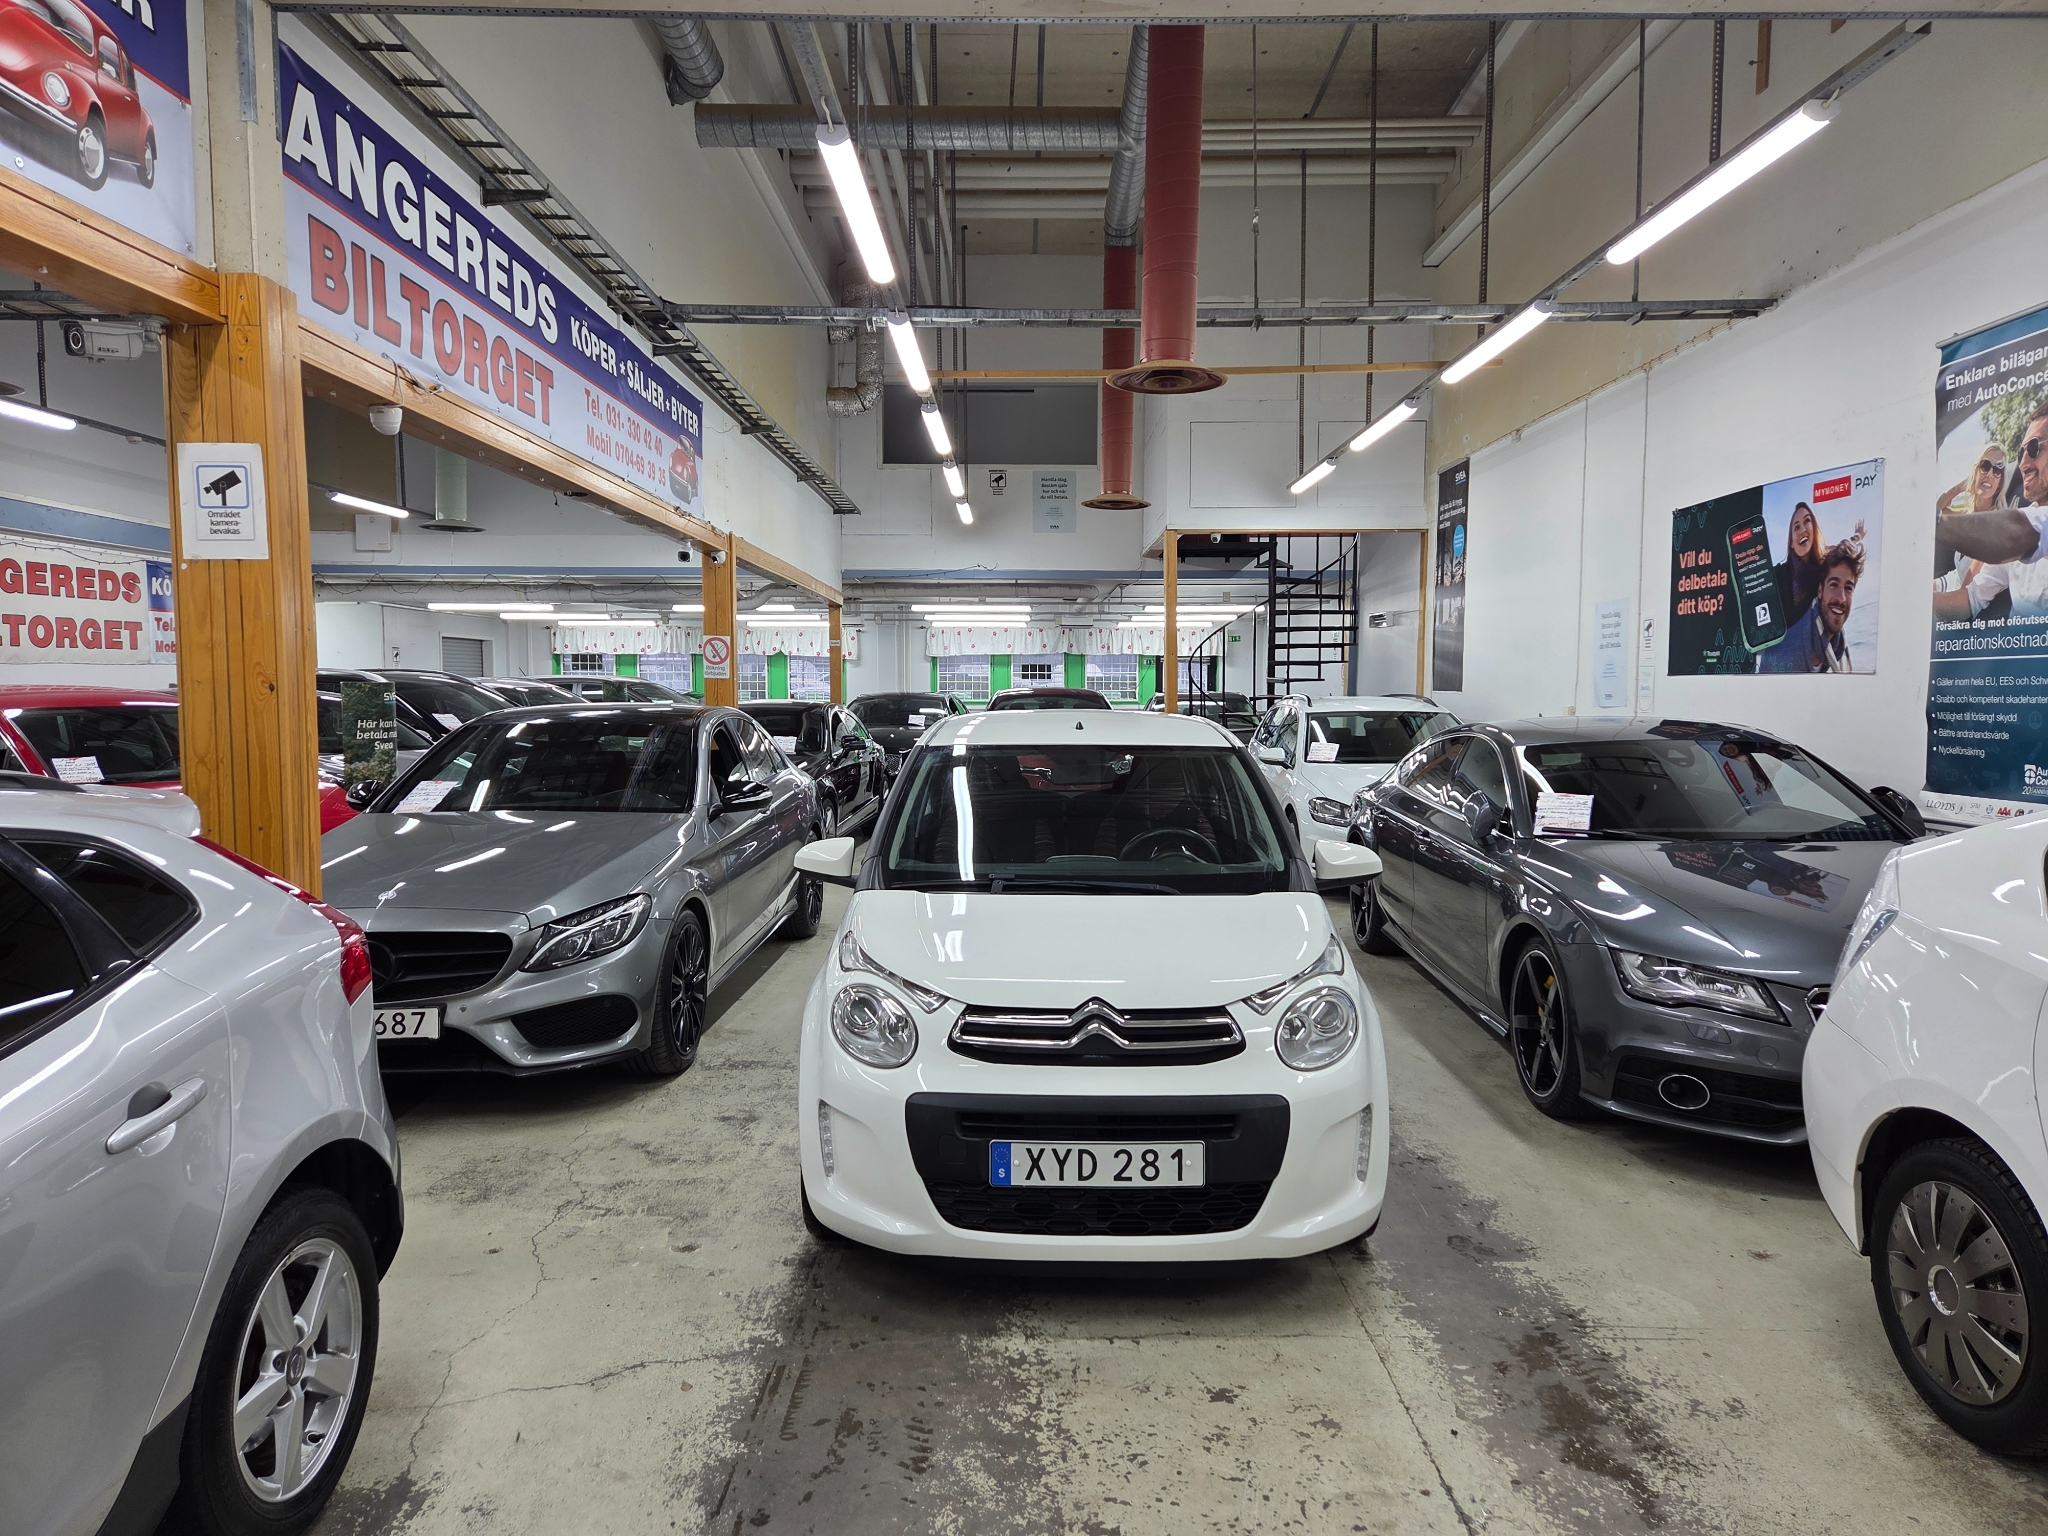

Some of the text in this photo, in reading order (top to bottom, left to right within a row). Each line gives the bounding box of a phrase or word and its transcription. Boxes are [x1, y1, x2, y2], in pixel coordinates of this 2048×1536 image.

[284, 82, 558, 345] ANGEREDS
[308, 213, 554, 427] BILTORGET
[570, 315, 699, 438] KÖPER SÄLJER BYTER
[1945, 363, 1996, 391] Enklare
[1947, 391, 1972, 412] med
[584, 388, 663, 458] Tel. 031- 330 42 40
[586, 424, 667, 487] Mobil 0704-69 39 35
[1814, 474, 1877, 497] MYMONEY PAY
[207, 510, 241, 518] Området
[210, 527, 241, 535] bevakas
[1679, 549, 1712, 569] Vill du
[1678, 570, 1728, 592] delbetala
[1677, 594, 1725, 616] ditt köp?
[0, 613, 143, 650] TORGET
[1936, 620, 1970, 631] Försäkra
[1972, 619, 1986, 630] dig
[1988, 617, 2005, 628] mot
[1936, 677, 1954, 686] Gäller
[1954, 677, 1969, 686] inom
[1970, 677, 1984, 686] hela
[1985, 676, 1998, 687] EU,
[1999, 676, 2014, 686] EES
[2015, 676, 2029, 685] och
[1936, 695, 1955, 703] Snabb
[1956, 695, 1968, 703] och
[1969, 695, 2004, 705] kompetent
[357, 719, 377, 729] Här
[379, 719, 392, 729] kan
[1937, 711, 1963, 722] Möjlighet
[1971, 711, 1995, 723] förlängt
[1996, 713, 2018, 723] skydd
[356, 730, 388, 739] betala
[1938, 728, 2010, 740] Bättre andrahandsvärde
[374, 741, 393, 750] Svea
[1938, 745, 1985, 758] Nyckelförsäkring
[374, 1011, 426, 1036] 687
[998, 1168, 1006, 1178] S
[1024, 1147, 1183, 1182] XYD 281
